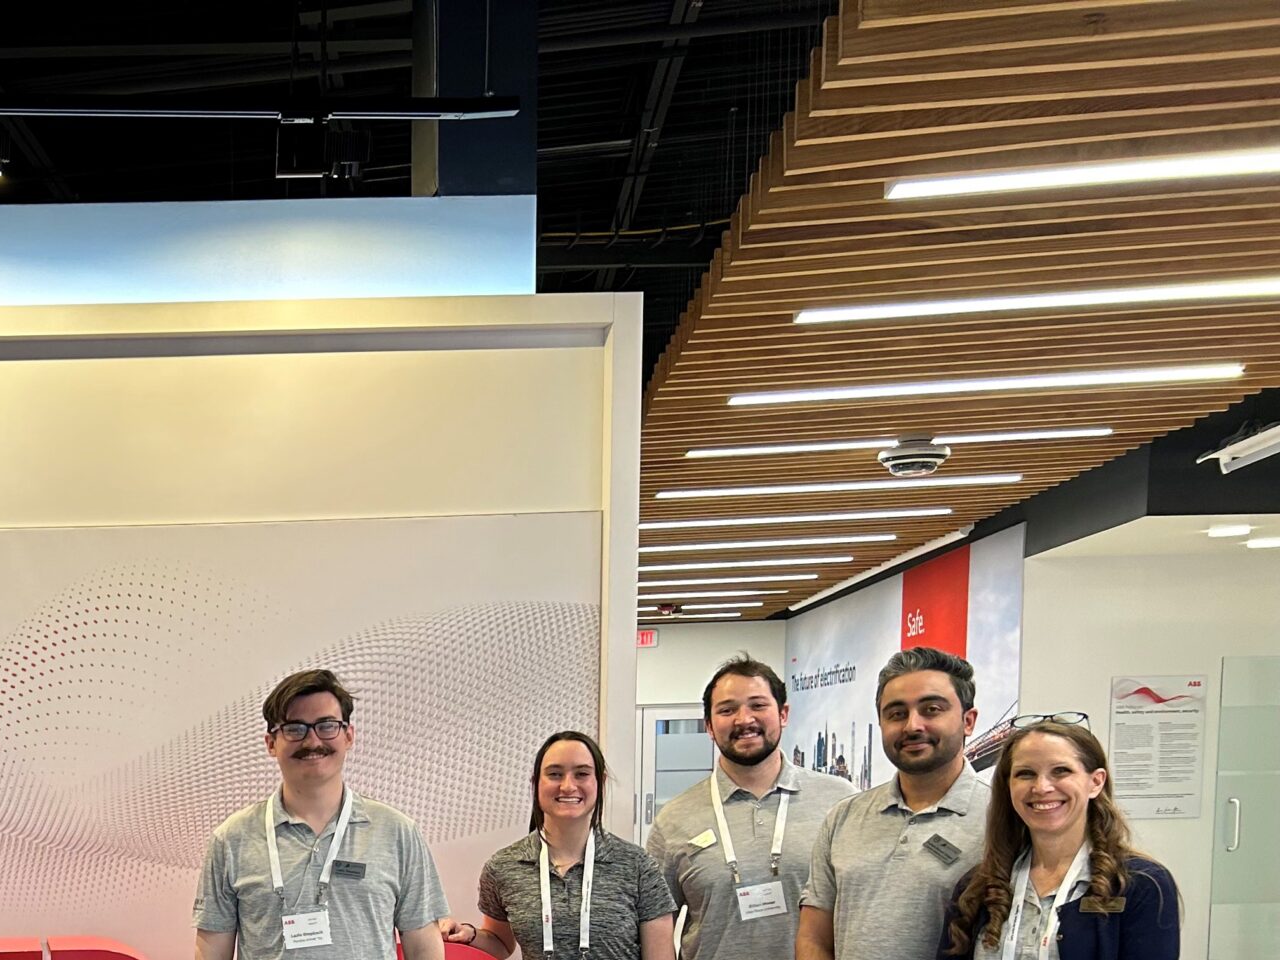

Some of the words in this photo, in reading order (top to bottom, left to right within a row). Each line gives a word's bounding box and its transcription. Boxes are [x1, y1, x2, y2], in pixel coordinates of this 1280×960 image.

[907, 609, 925, 637] Safe.
[800, 671, 814, 691] future
[820, 661, 856, 688] electrification
[1187, 680, 1202, 688] ABB
